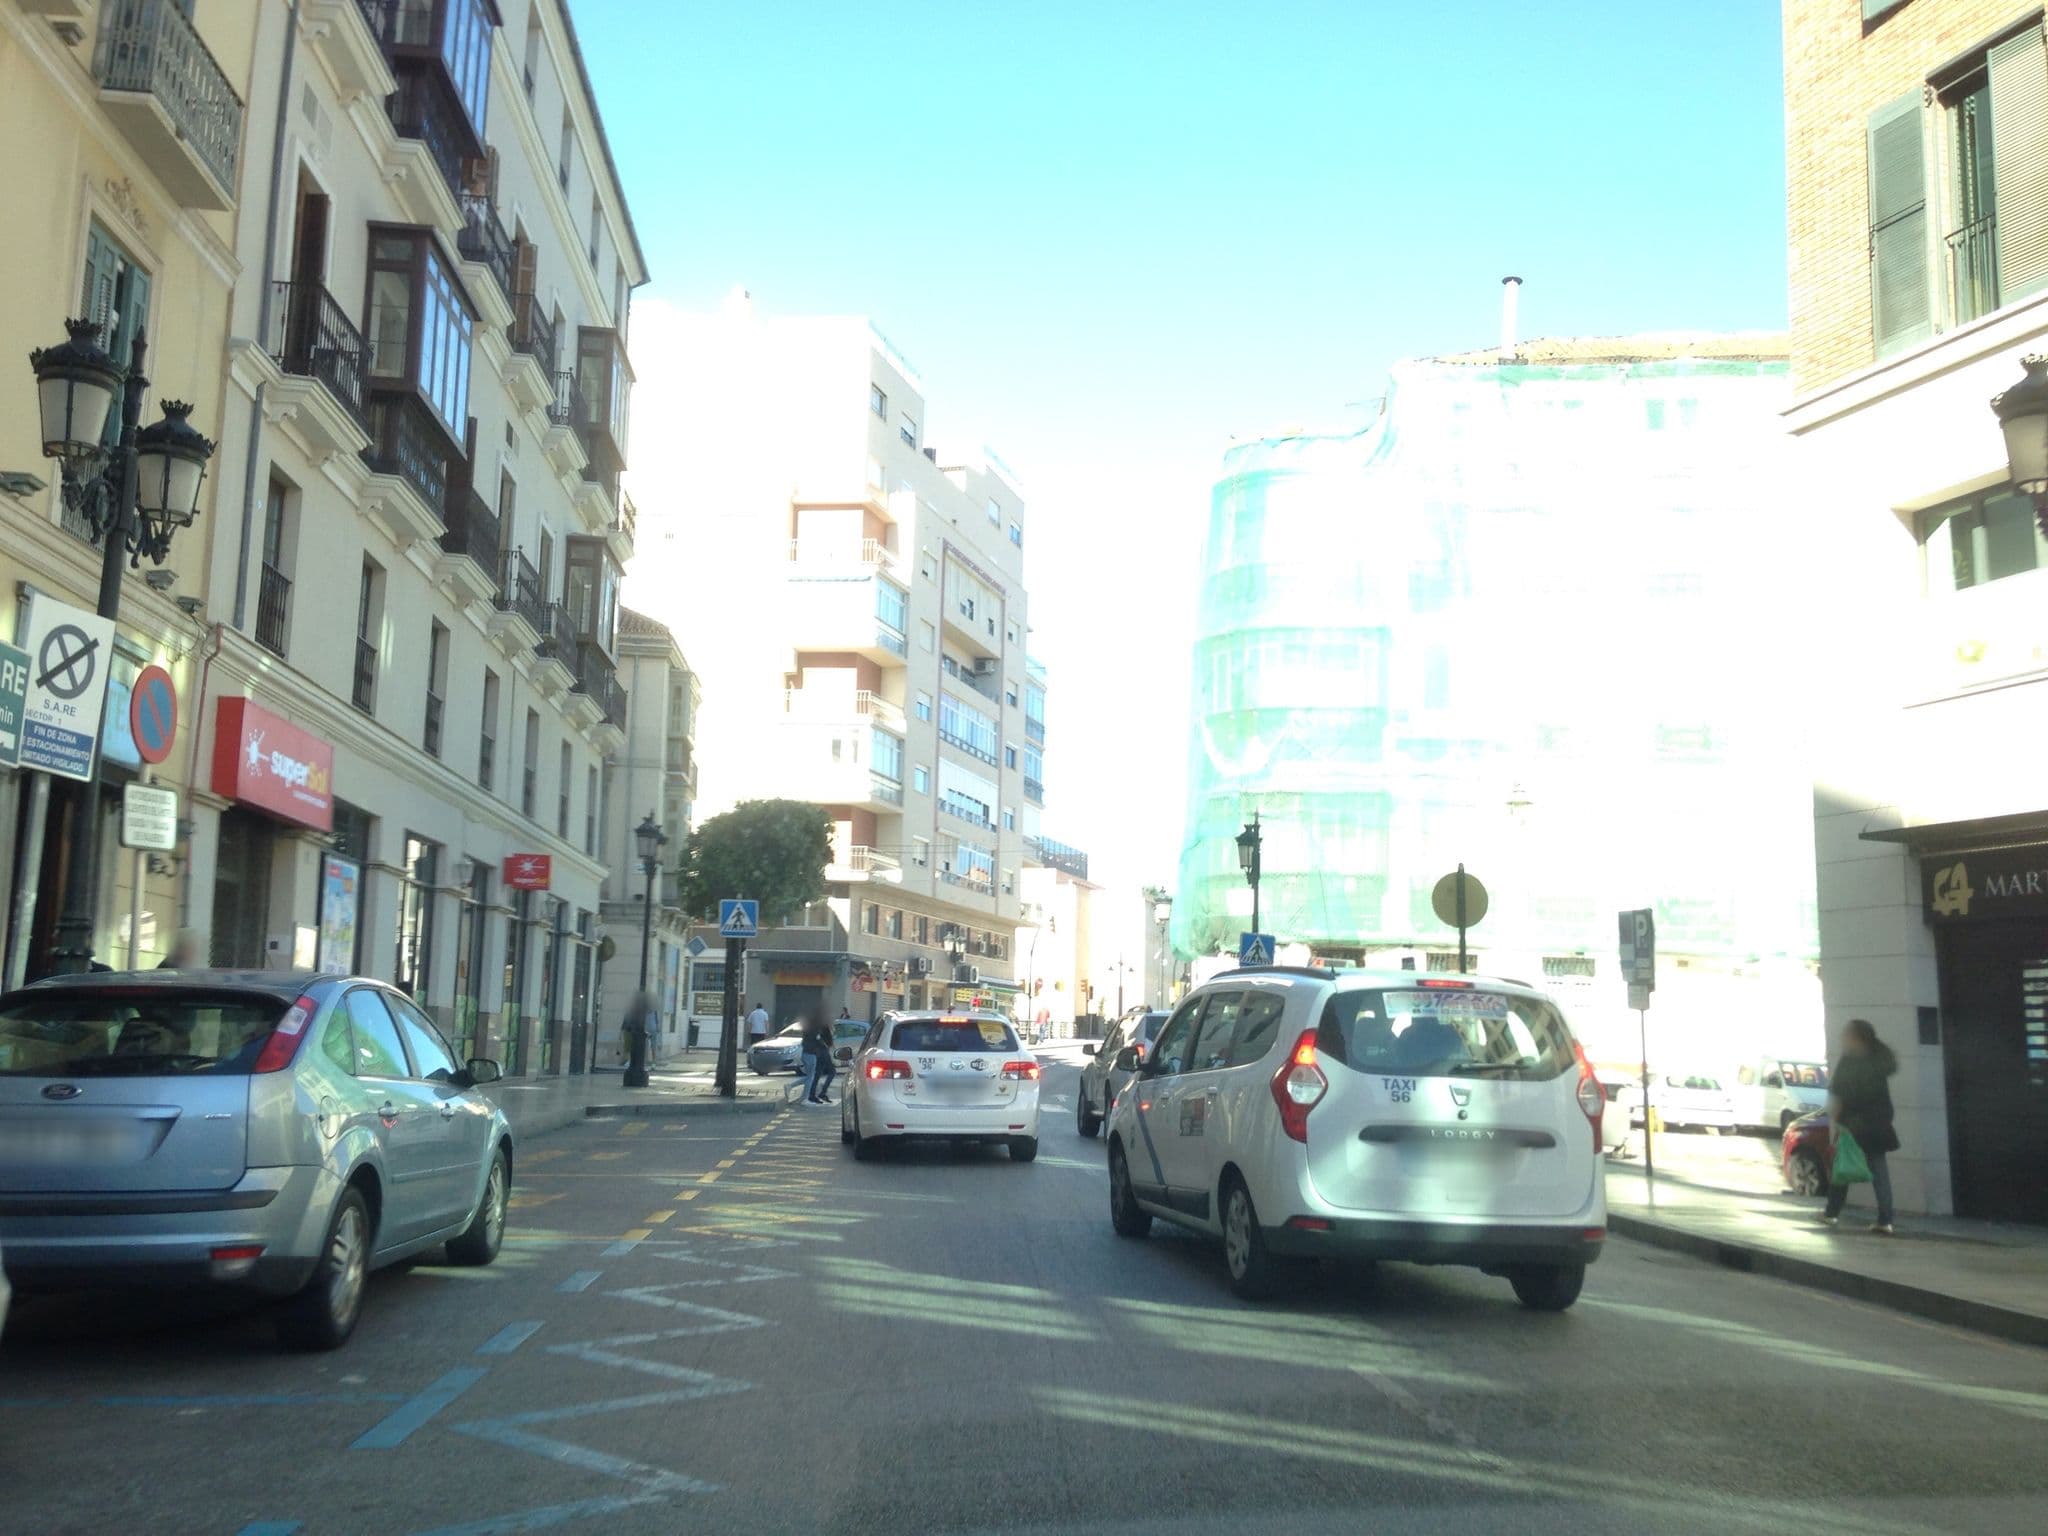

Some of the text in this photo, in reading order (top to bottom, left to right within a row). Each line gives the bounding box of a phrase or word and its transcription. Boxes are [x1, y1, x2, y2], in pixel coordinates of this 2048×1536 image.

[43, 699, 77, 717] S.A.RE
[34, 725, 77, 745] FIN DE ZONA
[27, 737, 90, 760] ESTACIONAMIENTO
[1381, 1078, 1417, 1091] TAXI
[1391, 1091, 1411, 1103] 56
